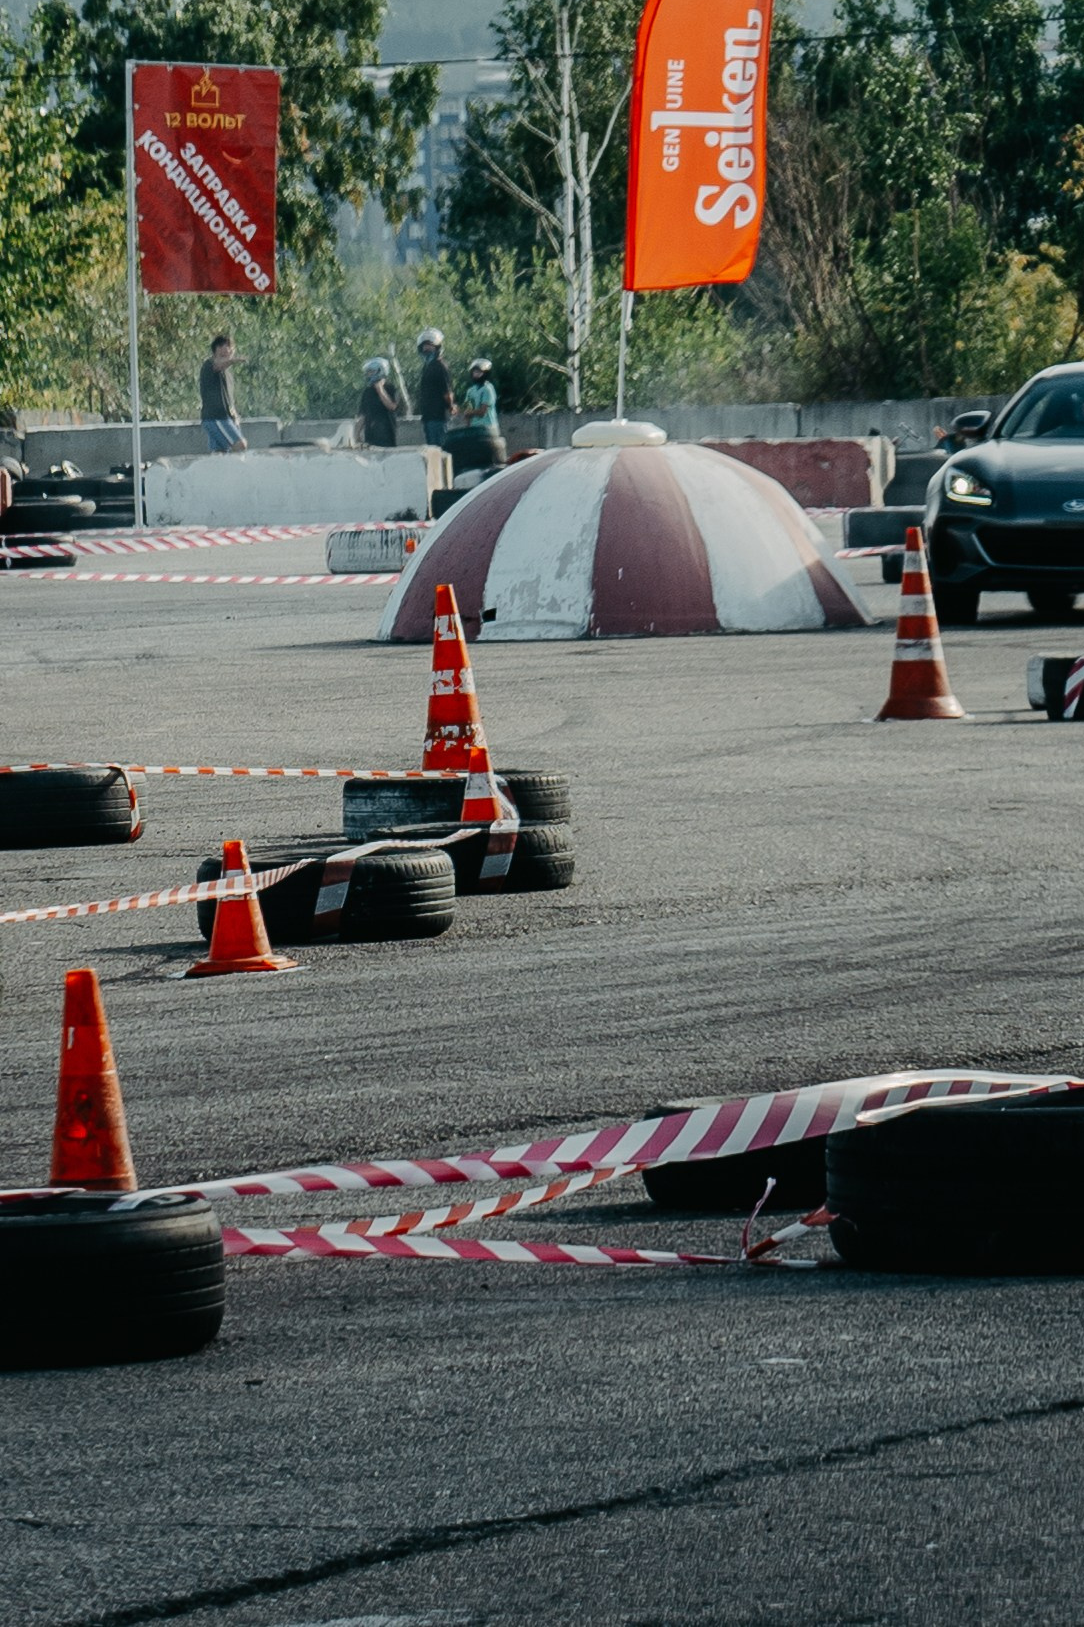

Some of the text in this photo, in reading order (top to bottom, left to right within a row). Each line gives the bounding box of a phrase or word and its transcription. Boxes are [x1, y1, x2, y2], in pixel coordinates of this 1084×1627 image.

[163, 111, 181, 129] 12
[650, 8, 764, 230] Seiken
[136, 129, 272, 292] КОНДИЦИОНЕРОВ
[179, 142, 258, 243] ЗАПРАВКА
